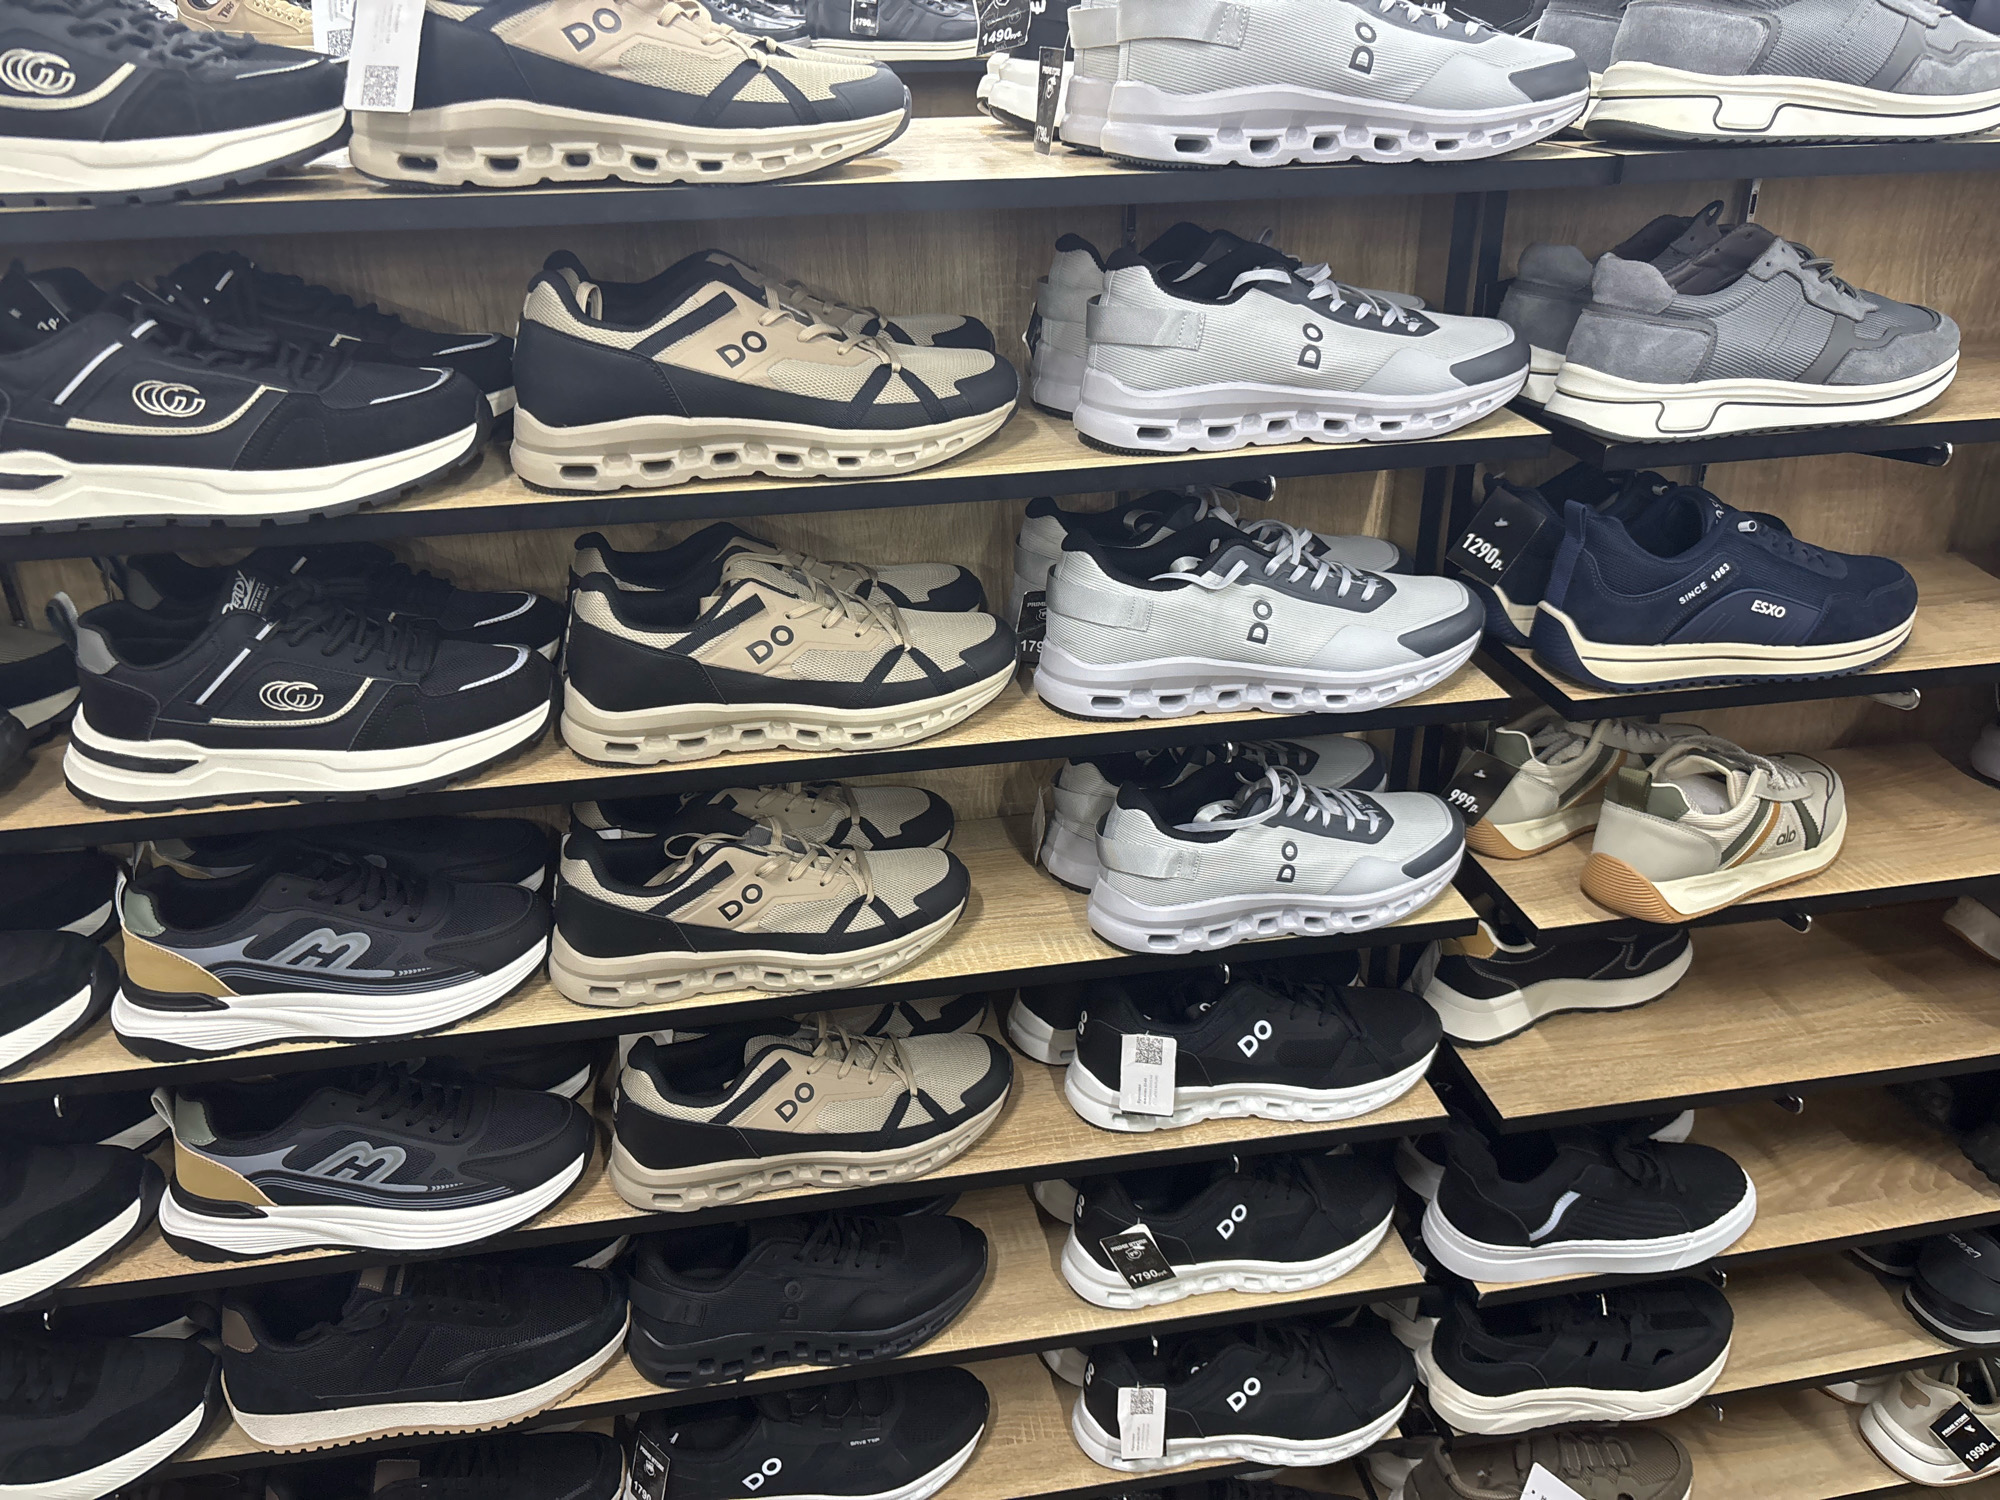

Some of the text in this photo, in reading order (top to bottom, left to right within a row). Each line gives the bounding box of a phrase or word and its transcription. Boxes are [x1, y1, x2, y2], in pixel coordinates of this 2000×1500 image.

[562, 8, 623, 53] DO
[1349, 21, 1377, 75] DO
[716, 330, 767, 369] DO
[1297, 323, 1324, 370] DO
[1462, 533, 1503, 571] 1290р.
[1678, 581, 1708, 605] SINCE
[1750, 599, 1786, 619] ESXO
[1246, 600, 1273, 645] DO
[746, 625, 795, 665] DO
[1447, 788, 1479, 814] 999р.
[1276, 840, 1298, 883] DO
[718, 883, 763, 922] DO
[1077, 1010, 1088, 1035] DO
[1237, 1019, 1272, 1058] DO
[775, 1082, 815, 1124] DO
[1216, 1203, 1247, 1240] DO
[1226, 1377, 1261, 1413] DO
[741, 1457, 782, 1491] DO
